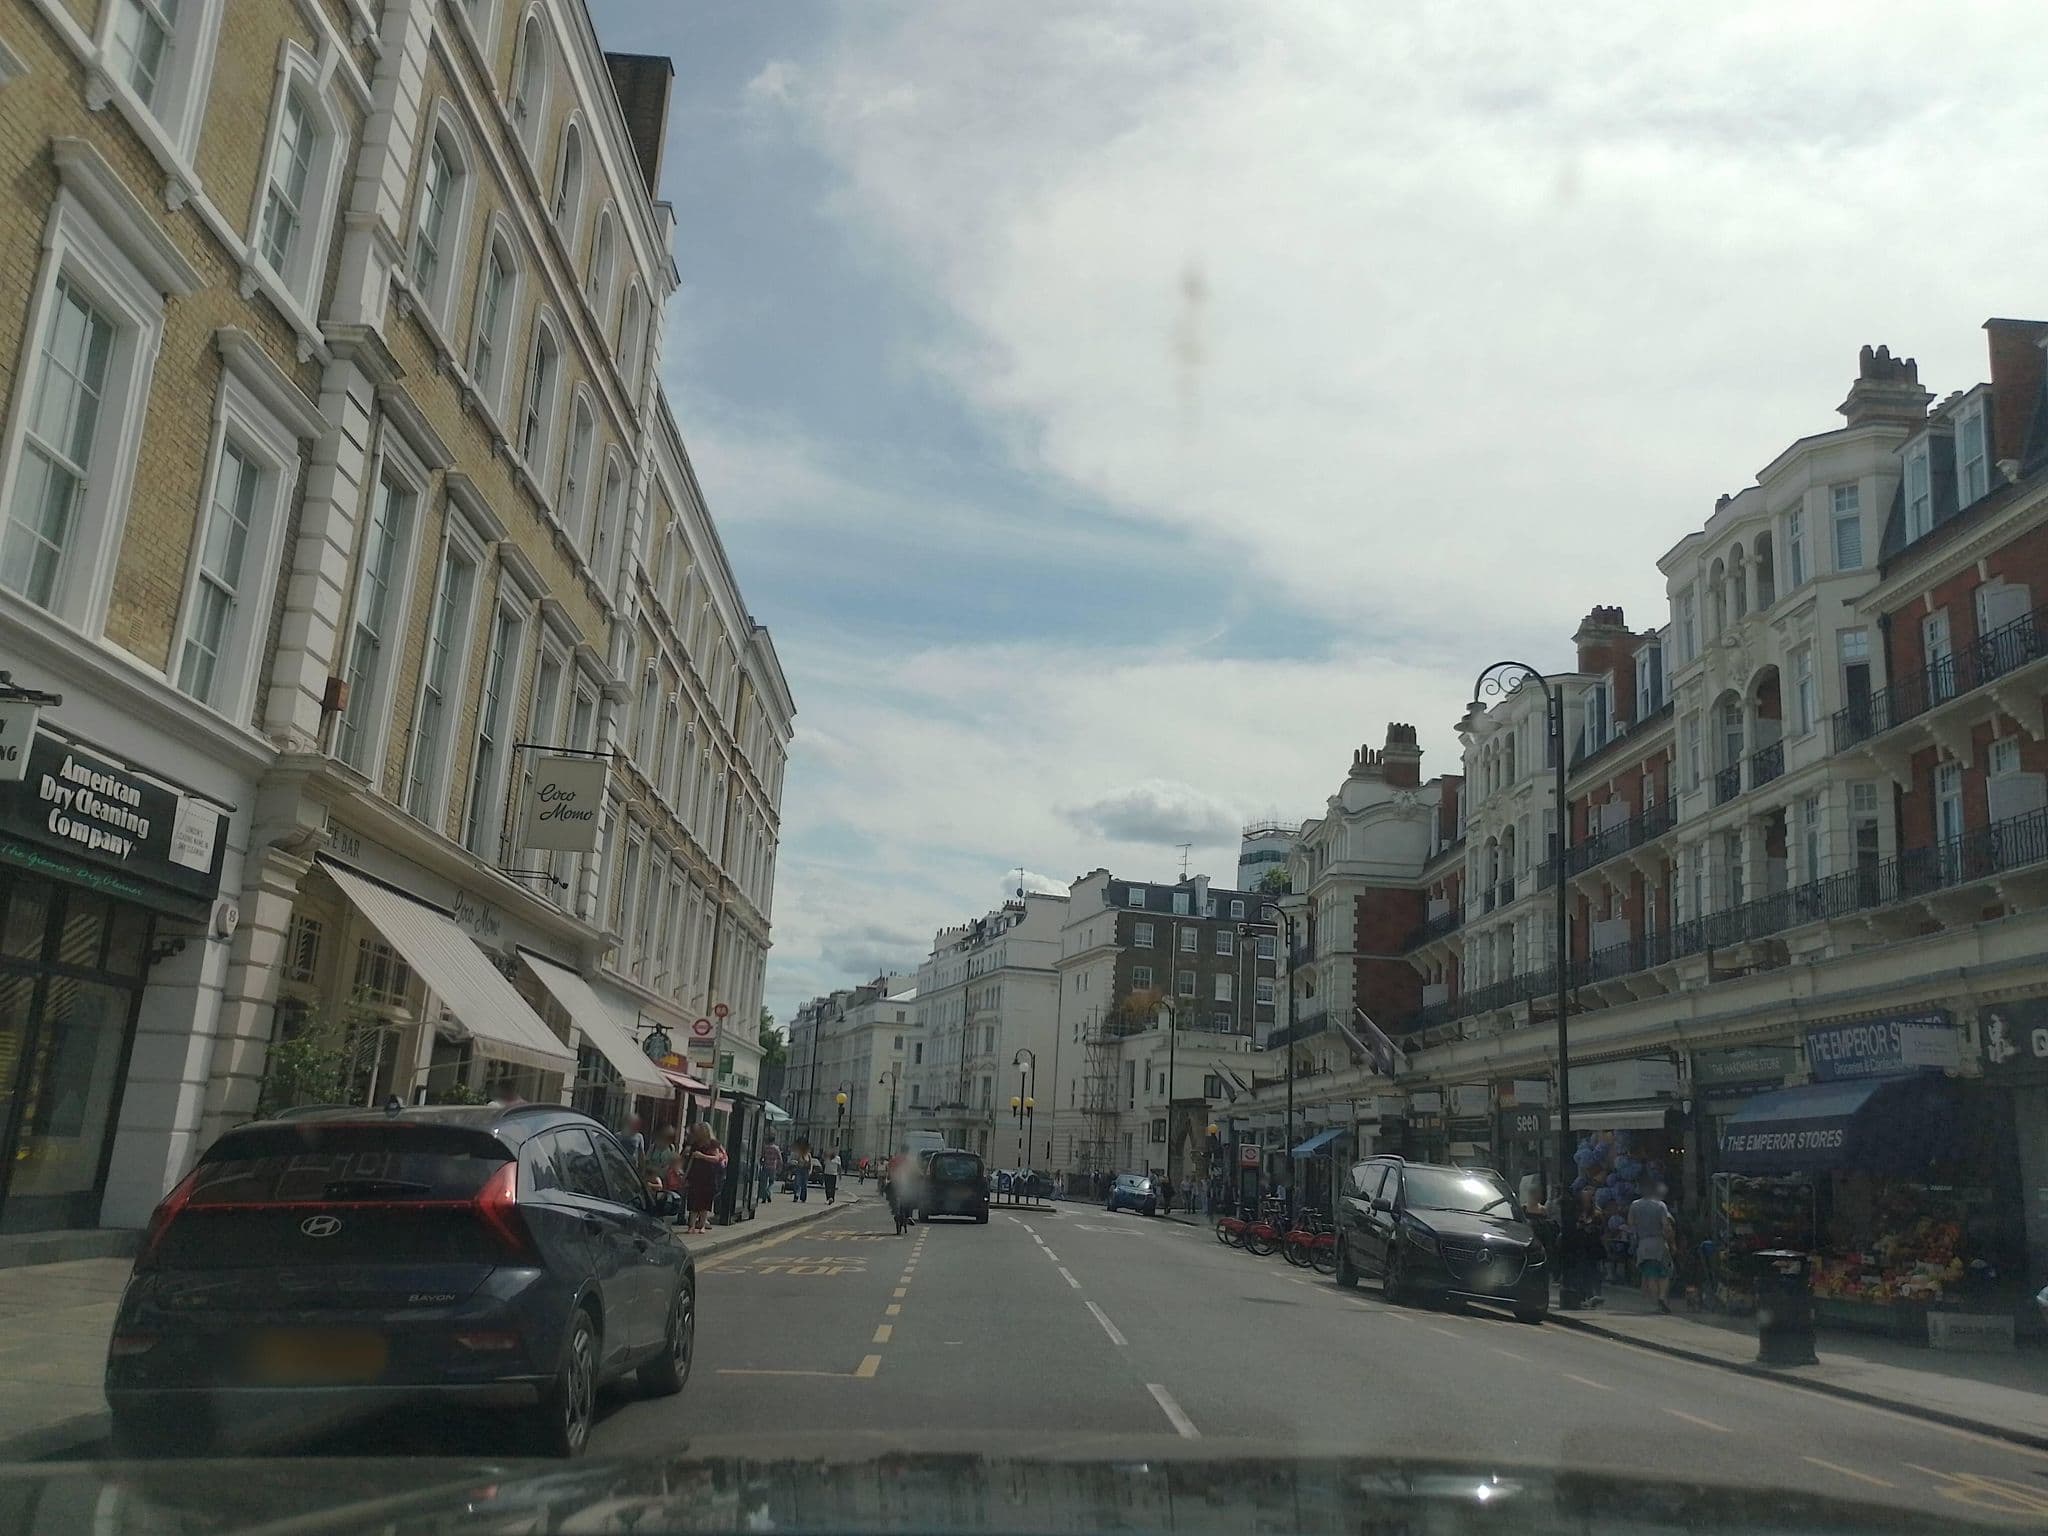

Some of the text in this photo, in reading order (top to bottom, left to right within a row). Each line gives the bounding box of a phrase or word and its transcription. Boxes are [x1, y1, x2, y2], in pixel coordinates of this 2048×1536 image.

[59, 754, 141, 808] American
[537, 783, 577, 802] Coco
[39, 773, 76, 811] Dry
[75, 788, 150, 840] Cleaning
[540, 802, 595, 822] Momo
[47, 807, 134, 860] Company
[341, 833, 361, 858] BAR
[1808, 1032, 1832, 1063] THE
[1829, 1024, 1890, 1060] EMPEROR
[1516, 1114, 1540, 1132] seen
[1727, 1135, 1746, 1152] THE
[1746, 1132, 1797, 1151] EMPEROR
[1797, 1129, 1843, 1149] STORES
[702, 1264, 868, 1276] STOP
[408, 1293, 456, 1303] BAYON
